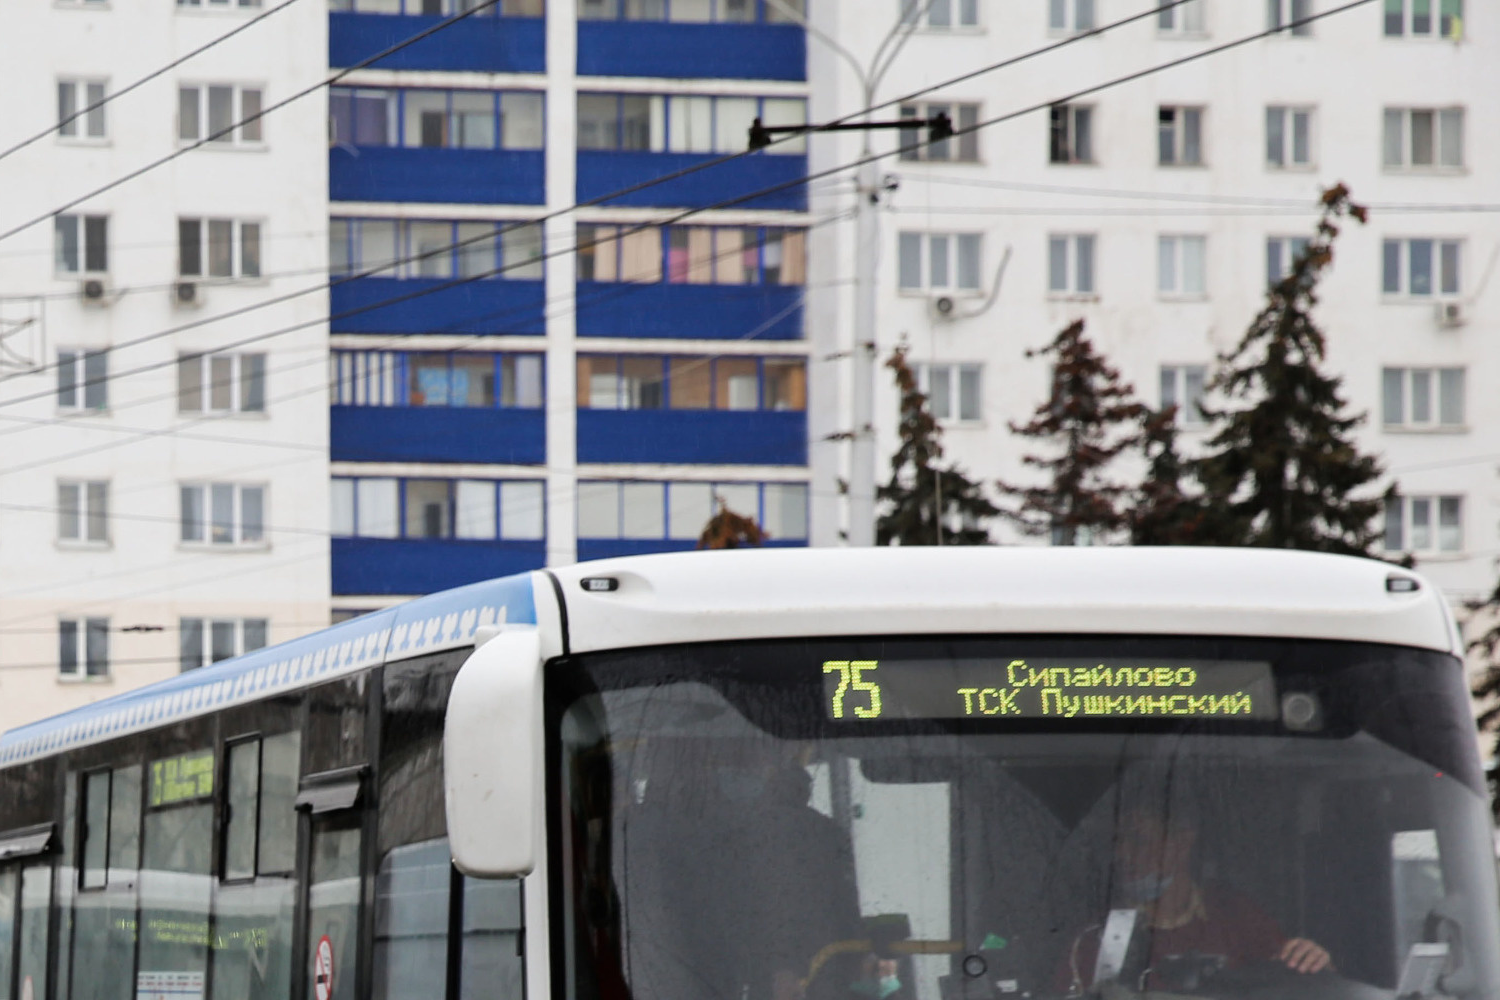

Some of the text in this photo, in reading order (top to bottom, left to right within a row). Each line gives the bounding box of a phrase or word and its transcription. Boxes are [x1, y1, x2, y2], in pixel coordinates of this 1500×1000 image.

[822, 659, 1198, 720] 75 Сипайлово
[957, 687, 1253, 718] ТСК Пушкинский
